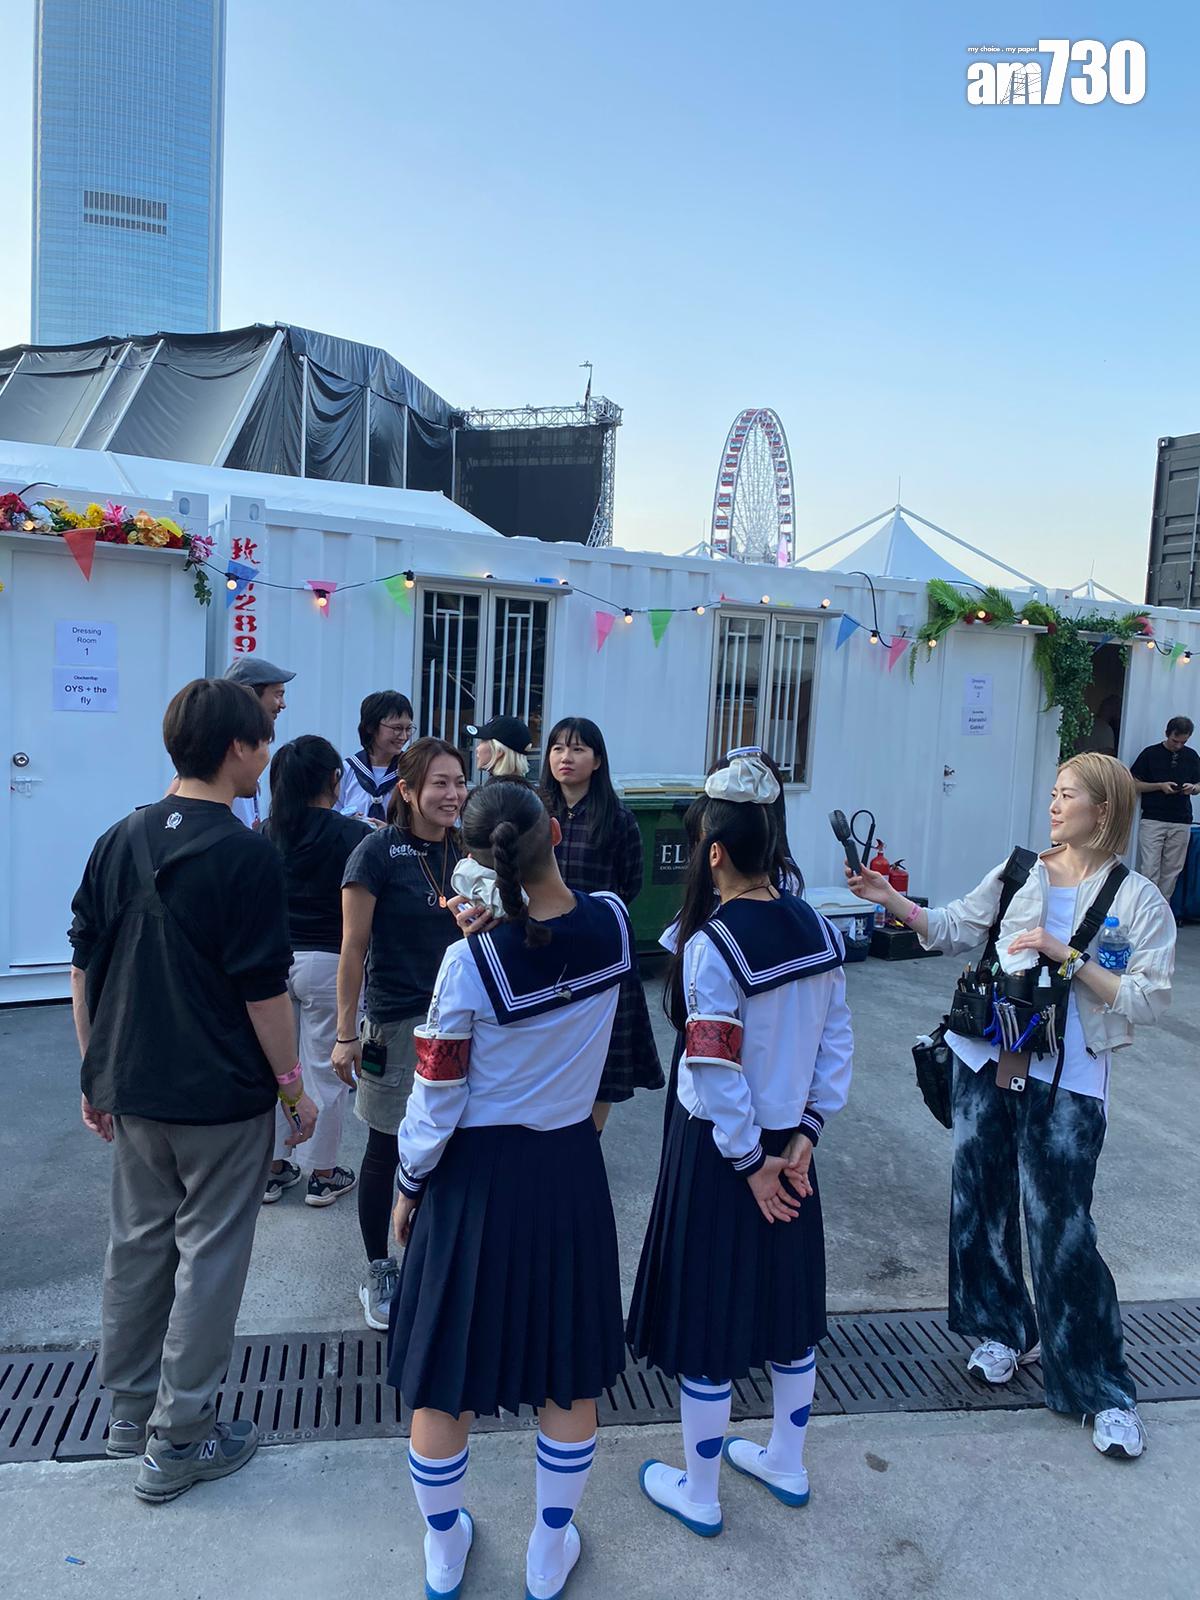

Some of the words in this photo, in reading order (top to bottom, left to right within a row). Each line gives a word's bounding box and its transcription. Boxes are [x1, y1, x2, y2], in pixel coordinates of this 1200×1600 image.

[72, 626, 102, 636] Dressing
[76, 636, 97, 644] Room
[84, 647, 89, 656] 1
[64, 685, 84, 693] OYS
[93, 686, 107, 694] the
[80, 696, 92, 706] fly
[200, 1440, 217, 1459] N
